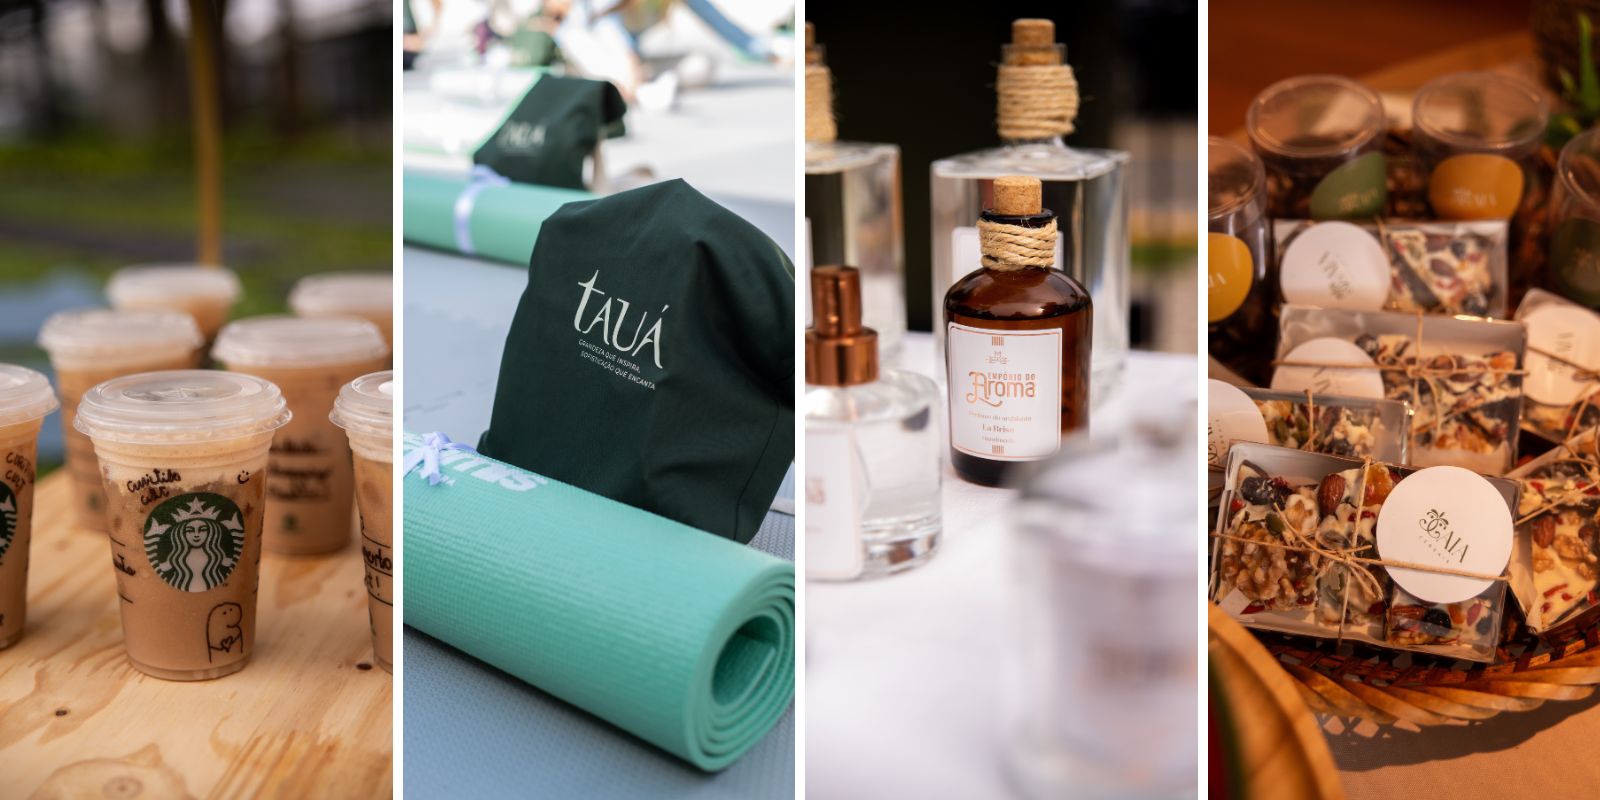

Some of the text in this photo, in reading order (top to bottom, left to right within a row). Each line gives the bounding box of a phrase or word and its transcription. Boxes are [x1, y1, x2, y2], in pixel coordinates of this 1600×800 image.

[578, 339, 605, 356] GRANDEZA
[604, 351, 617, 361] QUE
[614, 367, 628, 378] QUE
[627, 373, 656, 390] ENCANTA
[966, 371, 1036, 407] Aroma
